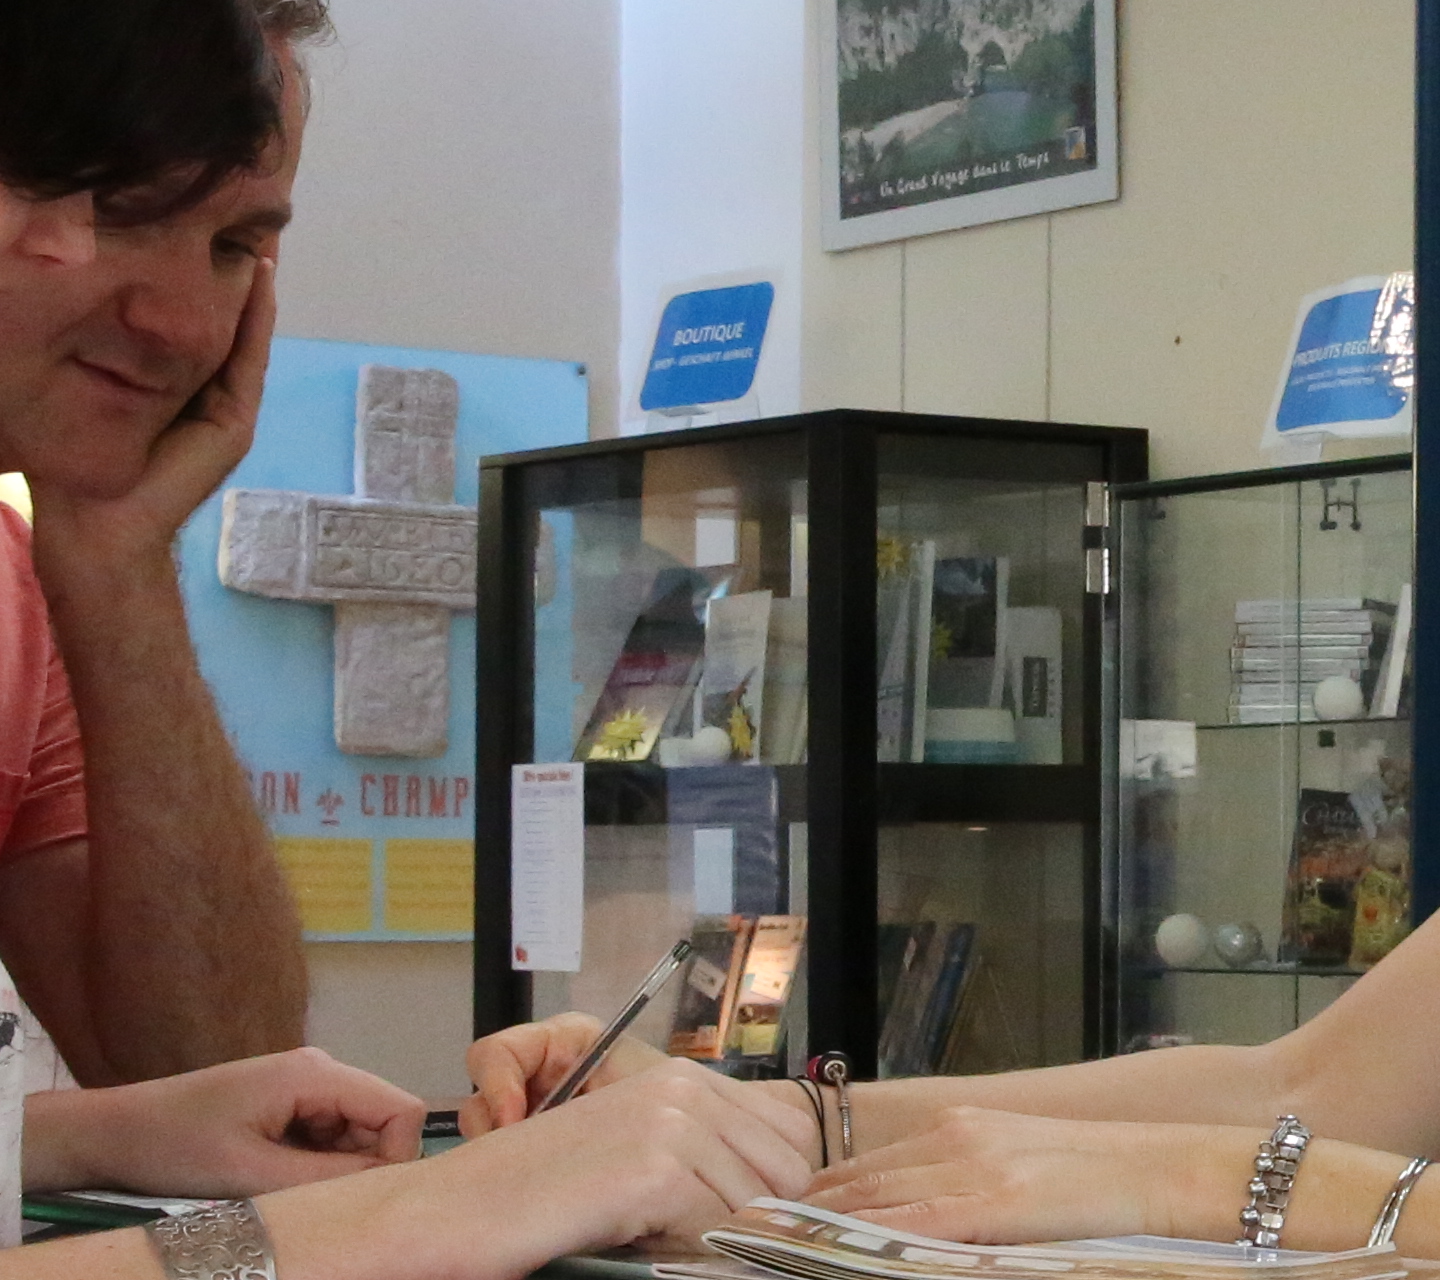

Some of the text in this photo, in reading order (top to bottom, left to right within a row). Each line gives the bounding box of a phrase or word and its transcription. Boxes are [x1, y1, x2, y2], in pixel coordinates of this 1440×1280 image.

[896, 177, 929, 195] Grand
[931, 168, 970, 191] Voyage
[1015, 151, 1050, 171] Temps
[673, 322, 745, 346] BOUTIQUE
[1293, 343, 1343, 368] PRODUITS
